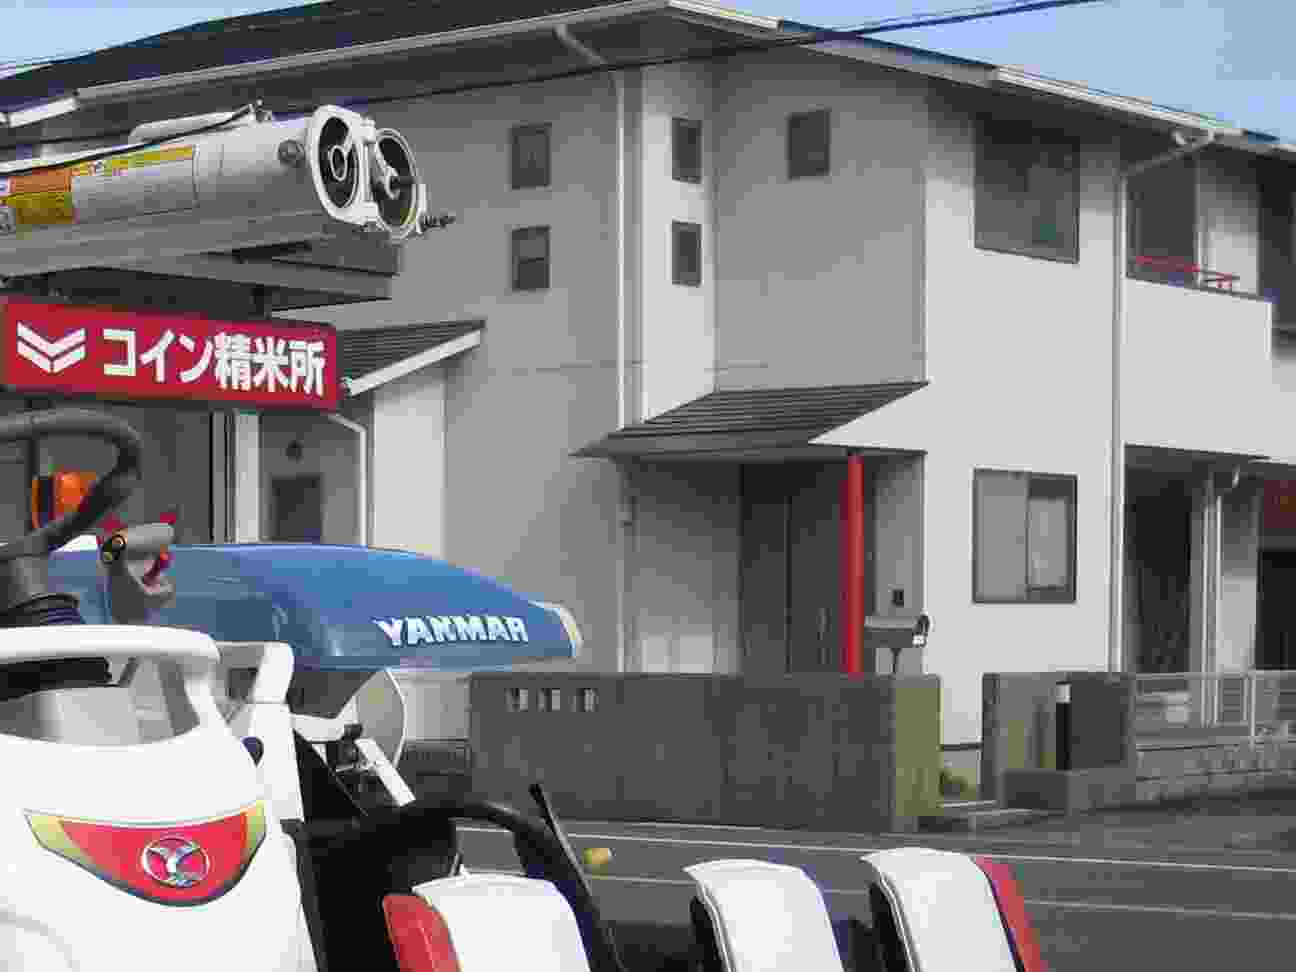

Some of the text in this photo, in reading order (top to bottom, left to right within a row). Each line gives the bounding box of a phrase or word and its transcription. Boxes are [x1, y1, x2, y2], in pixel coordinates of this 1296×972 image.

[102, 326, 326, 397] コイン精米所
[372, 614, 528, 647] YANMAR
